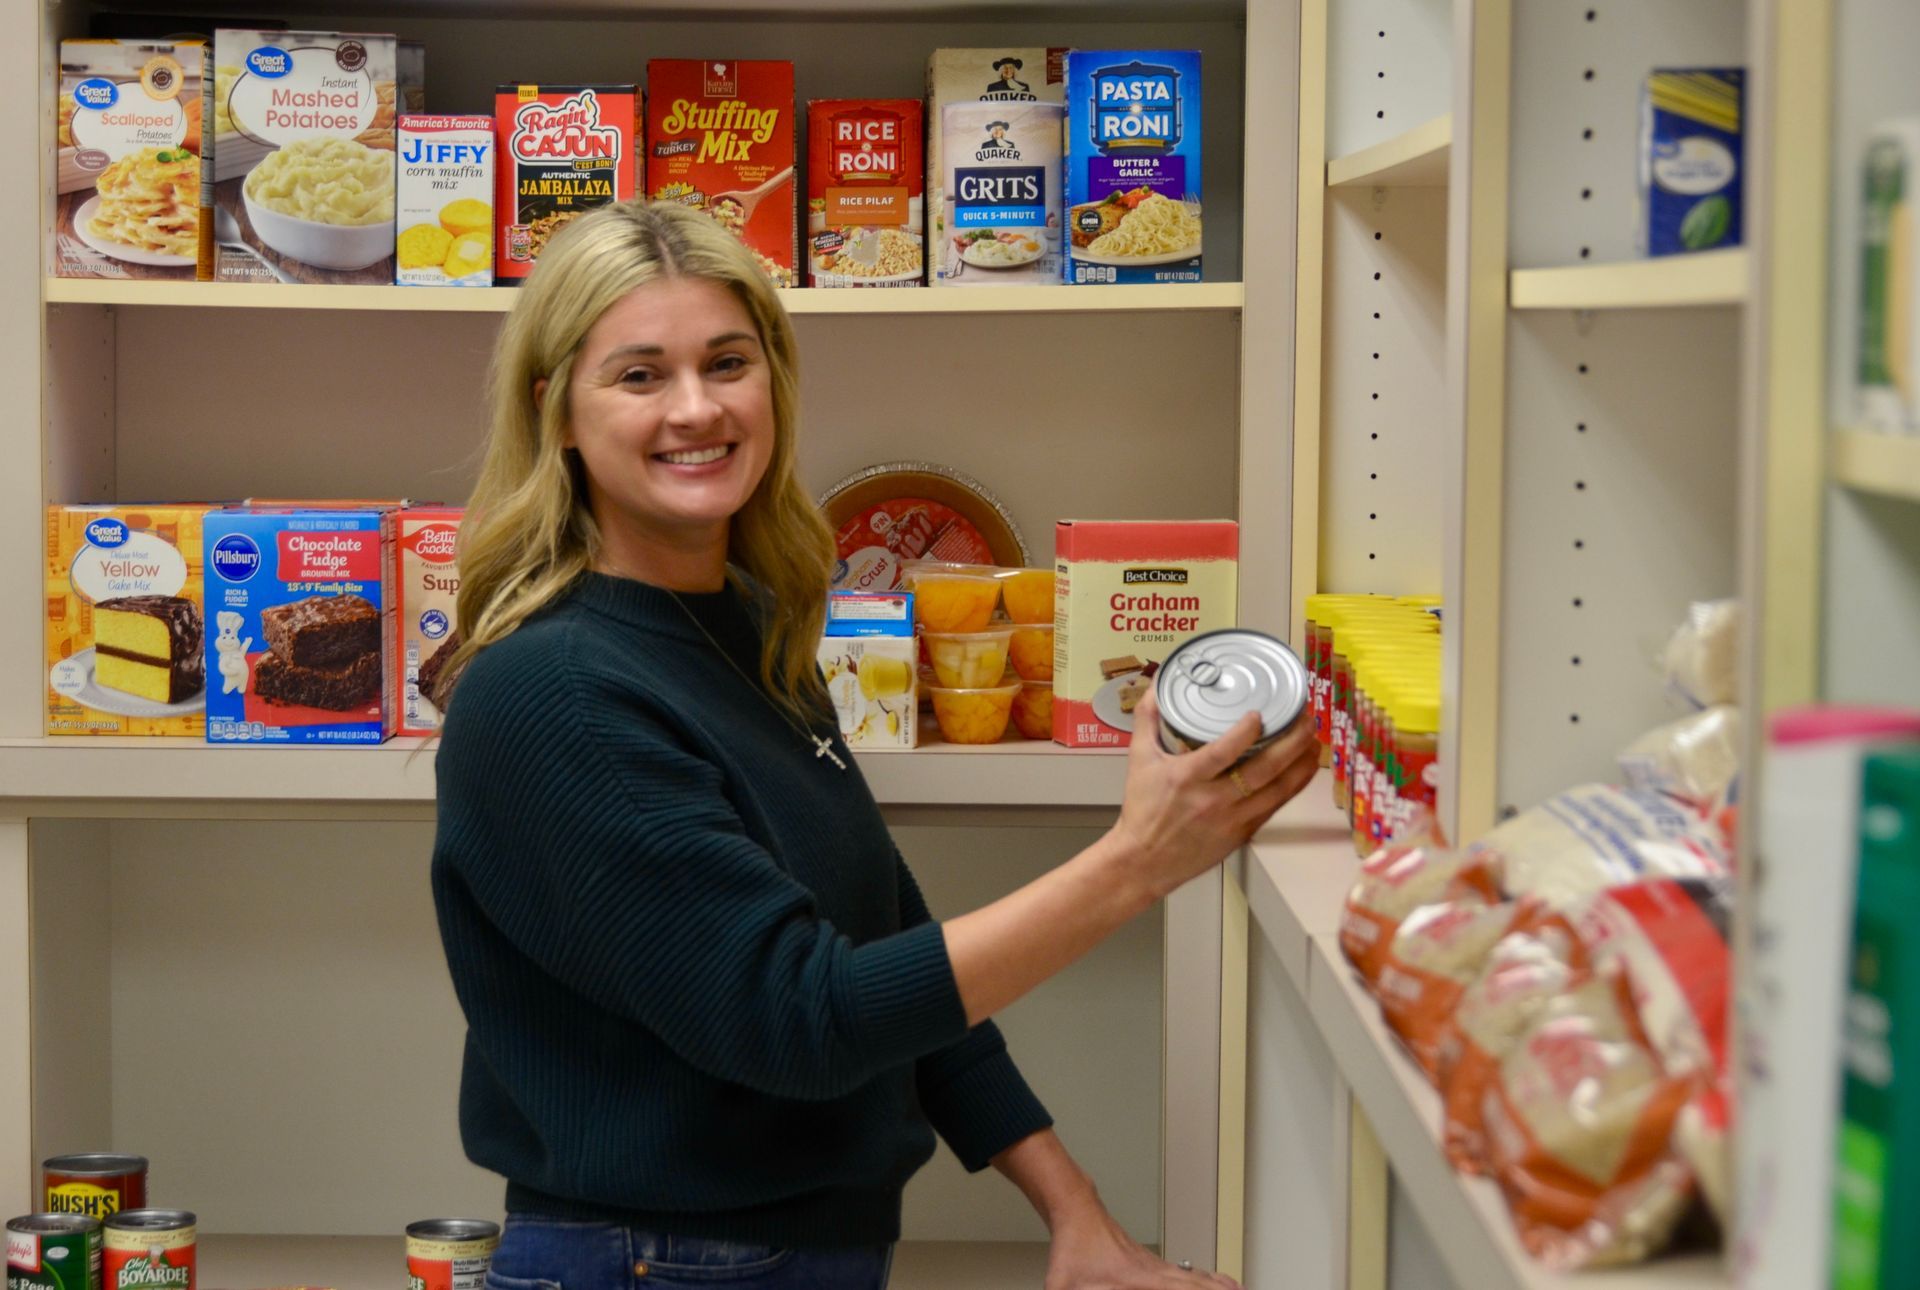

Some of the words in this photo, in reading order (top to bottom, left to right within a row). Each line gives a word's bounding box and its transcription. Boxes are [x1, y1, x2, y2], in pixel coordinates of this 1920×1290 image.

[251, 54, 285, 66] Great
[260, 64, 285, 72] Value
[322, 76, 358, 88] Instant
[80, 85, 111, 96] Great
[1102, 81, 1170, 100] PASTA
[86, 95, 111, 104] Value
[272, 89, 358, 108] Mashed
[101, 112, 173, 128] Scalloped
[266, 110, 358, 129] Potatoes
[402, 118, 449, 128] America's
[450, 118, 490, 129] Favorite
[662, 99, 779, 144] Stuffing
[1104, 115, 1168, 137] RONI
[137, 129, 172, 140] Potatoes
[838, 122, 895, 141] RICE
[403, 138, 488, 164] JIFFY
[517, 135, 612, 158] CAJUN
[657, 143, 695, 155] TURKEY
[696, 131, 753, 164] Mix
[840, 152, 895, 171] RONI
[976, 149, 1020, 161] QUAKER
[575, 161, 593, 169] C'EST
[1113, 159, 1150, 167] BUTTER
[406, 167, 435, 177] corn
[440, 166, 483, 178] muffin
[432, 178, 458, 190] mix
[520, 180, 612, 196] JAMBALAYA
[960, 176, 1038, 202] GRITS
[557, 197, 573, 205] MIX
[840, 197, 862, 206] RICE
[963, 212, 988, 220] QUICK
[990, 211, 1036, 220] 5-MINUTE
[90, 525, 122, 536] Great
[98, 534, 122, 543] Value
[288, 536, 362, 552] Chocolate
[416, 540, 455, 555] Crocke
[216, 550, 258, 567] Pillsbury
[303, 552, 348, 570] Fudge
[100, 561, 160, 578] Yellow
[859, 558, 888, 587] Crust
[1126, 571, 1148, 582] Best
[1150, 571, 1185, 582] Choice
[108, 580, 131, 591] Cake
[134, 580, 151, 591] Mix
[314, 582, 343, 594] Family
[344, 583, 363, 592] Size
[423, 574, 460, 595] Sup
[1110, 593, 1199, 611] Graham
[1110, 614, 1199, 631] Cracker
[51, 1193, 115, 1214] BUSH'S
[125, 1258, 146, 1271] Chef
[118, 1266, 188, 1288] BOYARDEE
